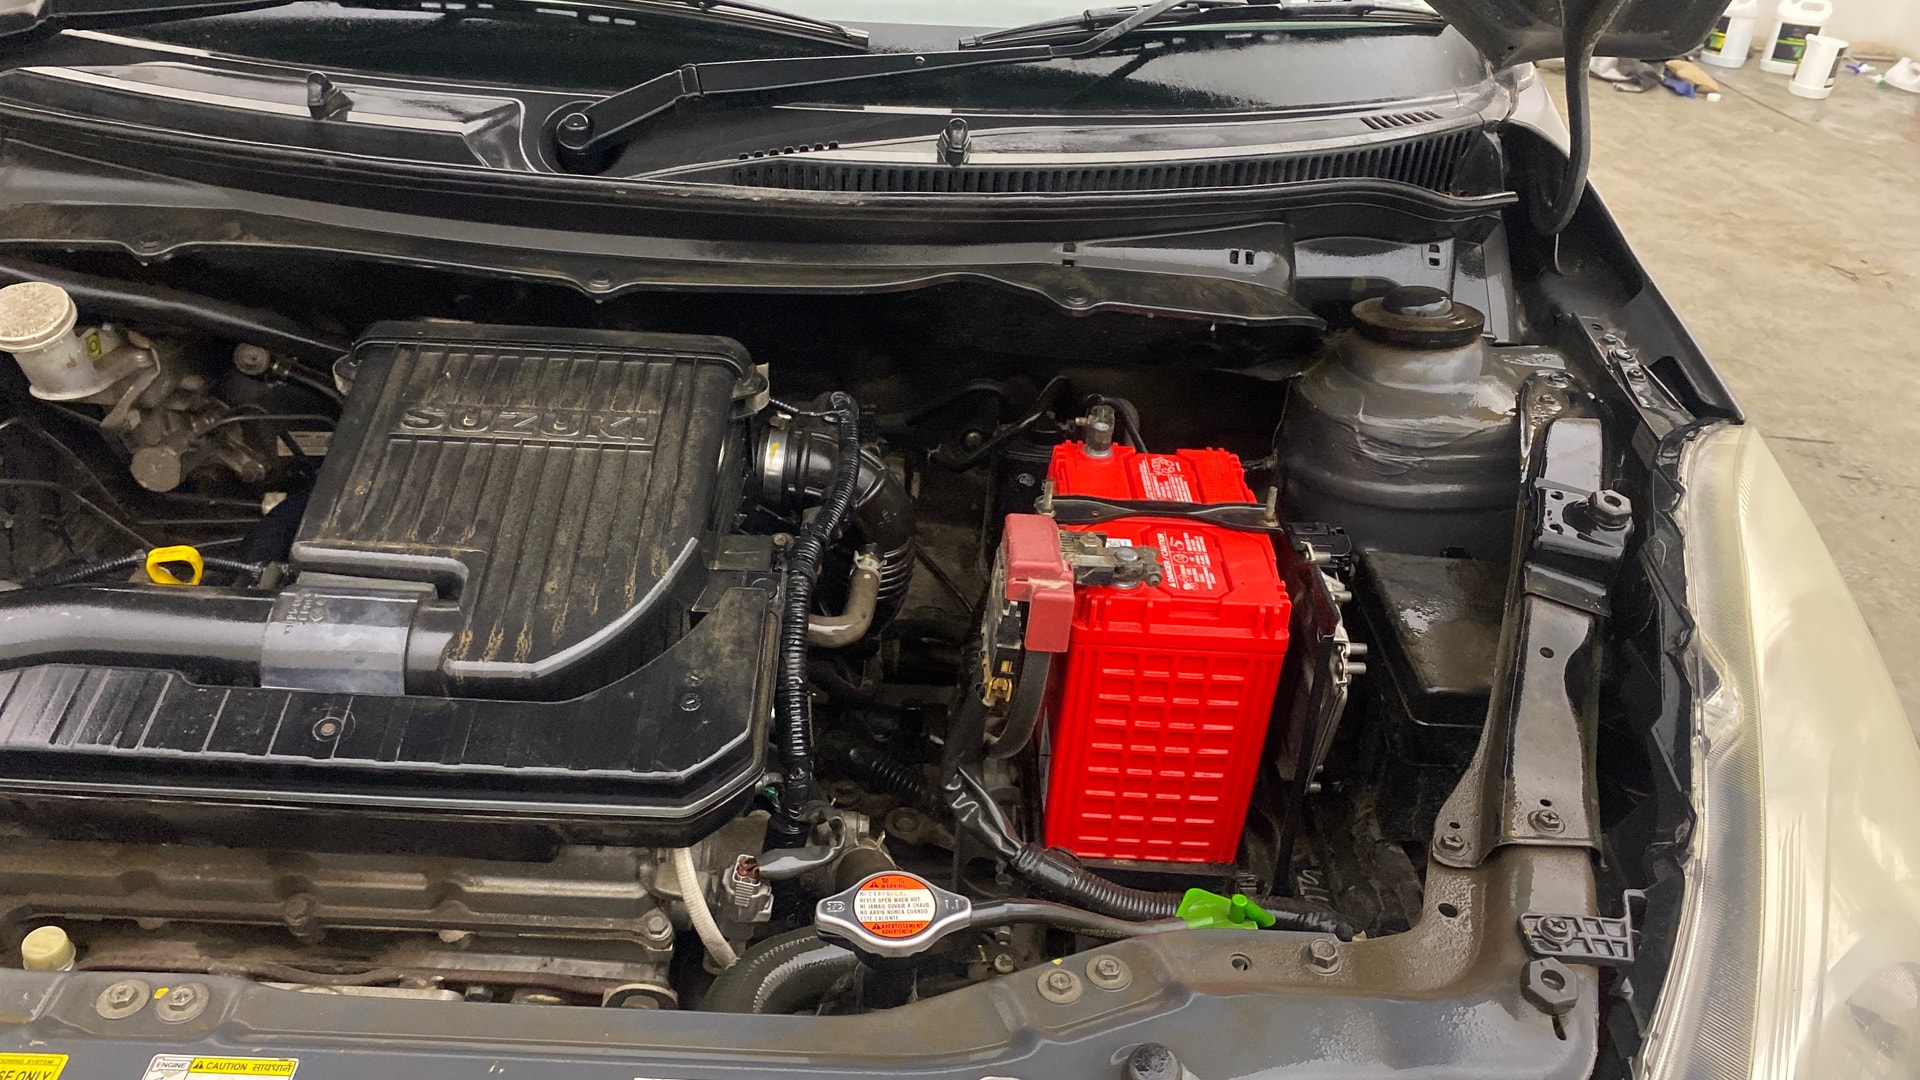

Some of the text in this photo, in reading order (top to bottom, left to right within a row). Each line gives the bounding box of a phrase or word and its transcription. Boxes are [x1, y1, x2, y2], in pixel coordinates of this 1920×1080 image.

[400, 406, 649, 441] SUZUKI
[1156, 533, 1169, 556] CAUTION
[205, 1061, 248, 1071] CAUTION
[15, 1070, 52, 1080] ONLY
